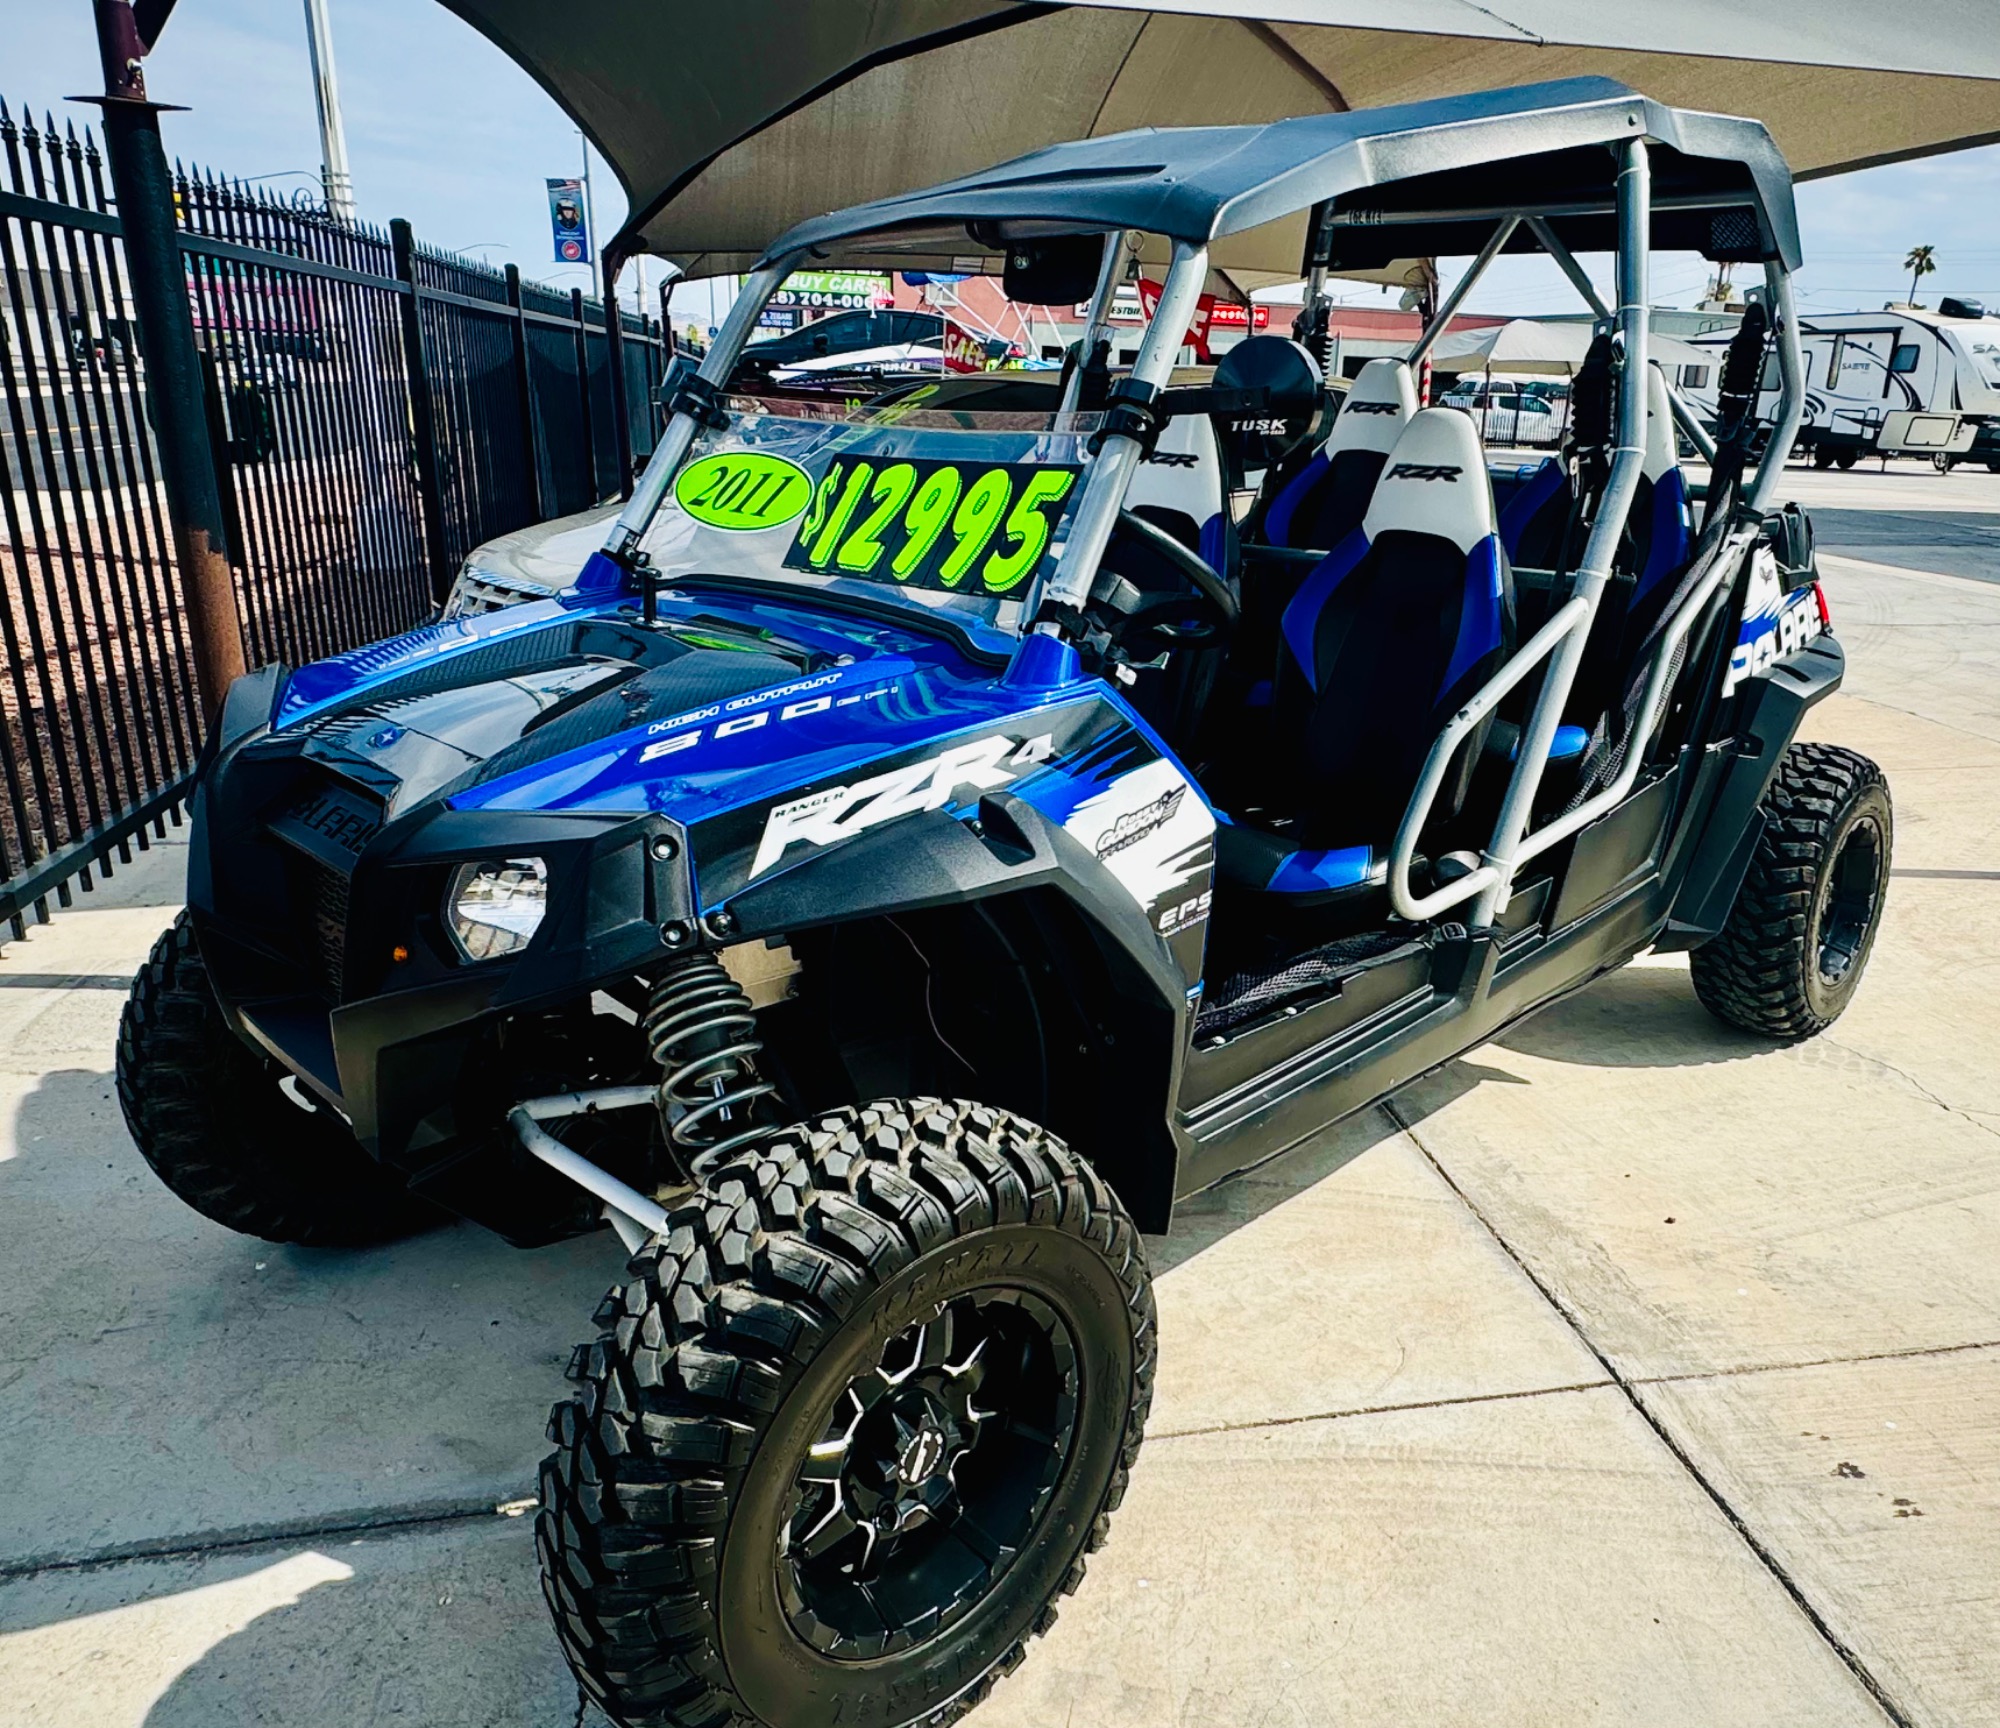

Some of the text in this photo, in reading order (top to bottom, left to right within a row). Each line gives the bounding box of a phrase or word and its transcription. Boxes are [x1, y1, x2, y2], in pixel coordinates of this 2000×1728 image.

[785, 275, 826, 289] BUY
[944, 333, 986, 368] SALE
[1231, 418, 1289, 432] TUSK
[1343, 401, 1400, 416] RZR
[1384, 463, 1464, 483] RZR
[688, 465, 796, 518] 2011
[799, 461, 1076, 592] $12995
[647, 672, 843, 735] HIGH OUTPUT
[638, 695, 832, 764] 800
[774, 791, 845, 818] RANGER
[1158, 889, 1213, 930] EPS
